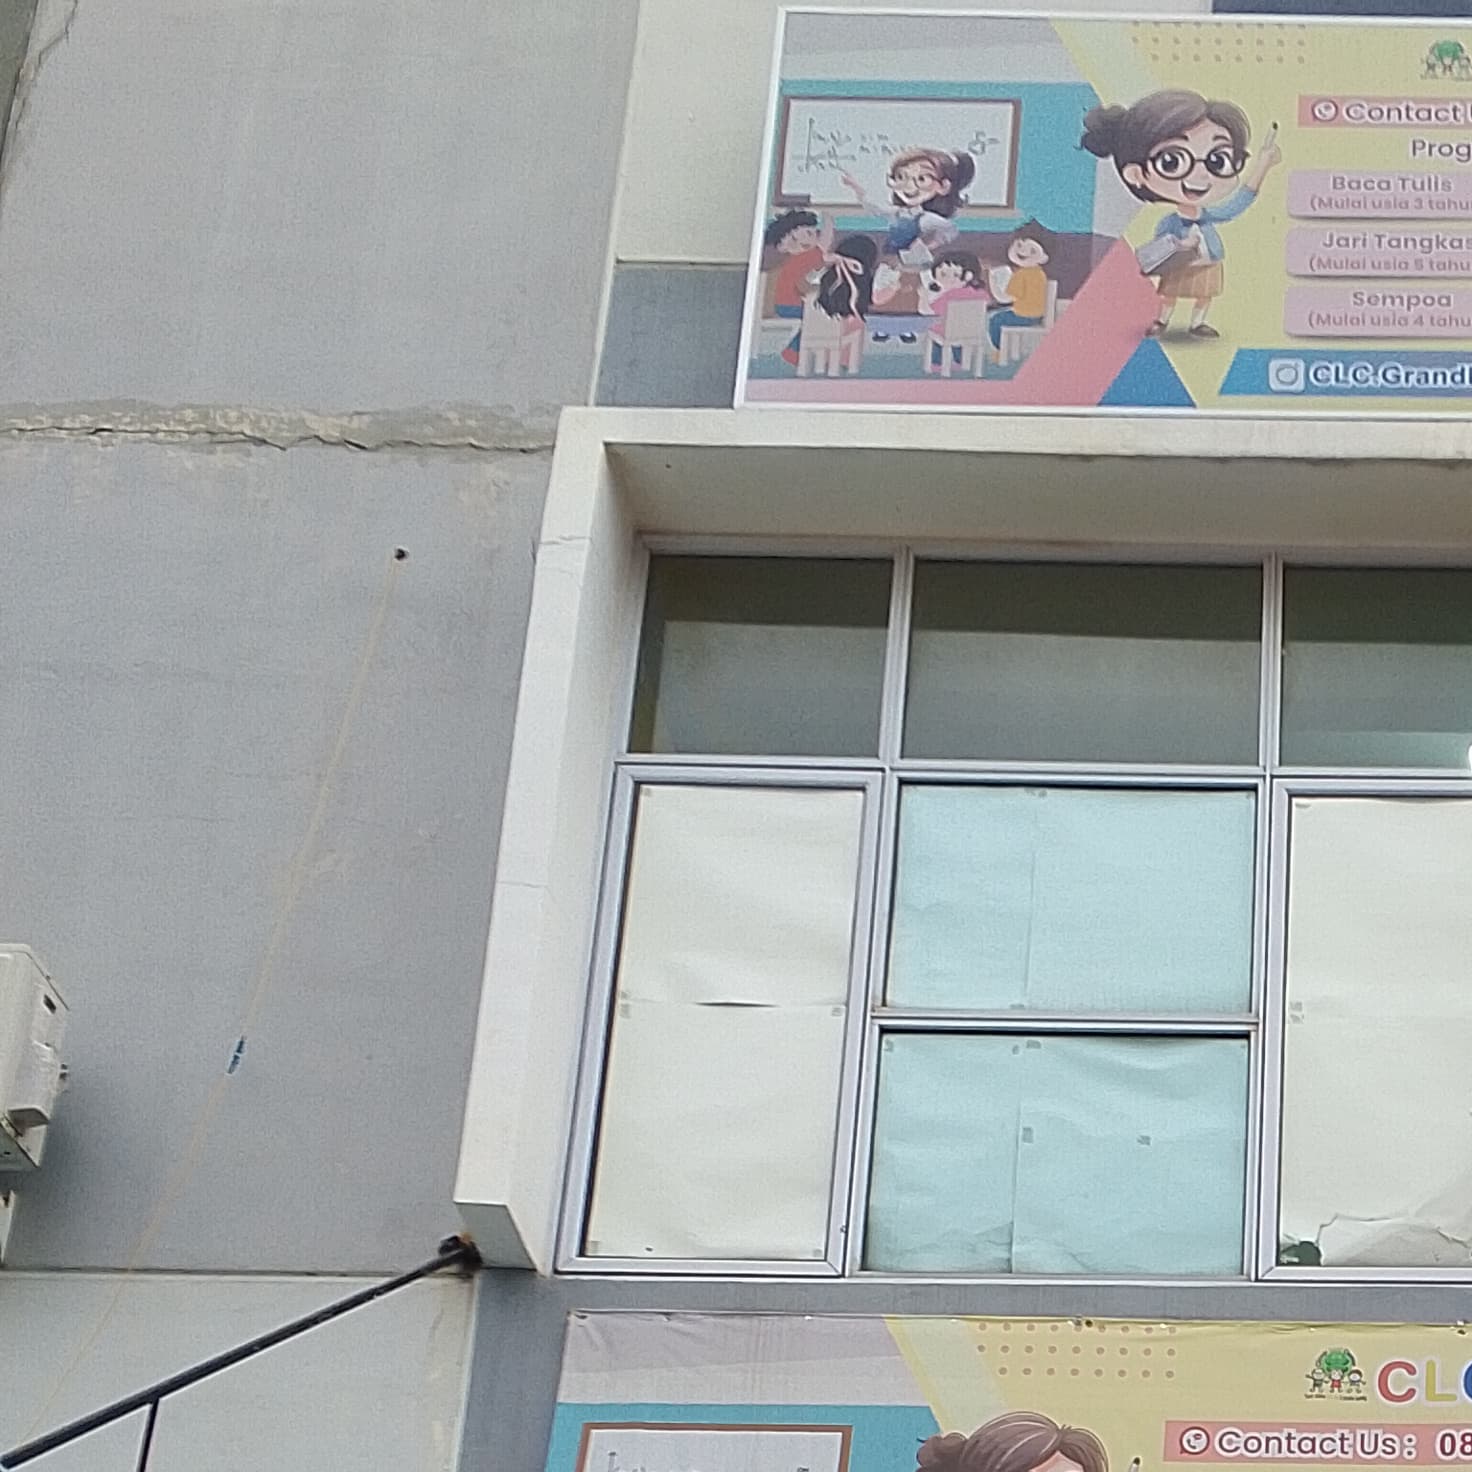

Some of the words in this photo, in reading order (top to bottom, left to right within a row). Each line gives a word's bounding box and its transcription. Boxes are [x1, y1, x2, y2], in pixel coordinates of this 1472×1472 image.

[1344, 101, 1460, 125] Contact
[1331, 175, 1391, 191] Baca
[1398, 176, 1453, 193] Tulis
[1322, 232, 1368, 249] Jari
[1352, 291, 1453, 312] Sempoa
[1412, 315, 1425, 327] 4
[1217, 1428, 1354, 1457] Contact
